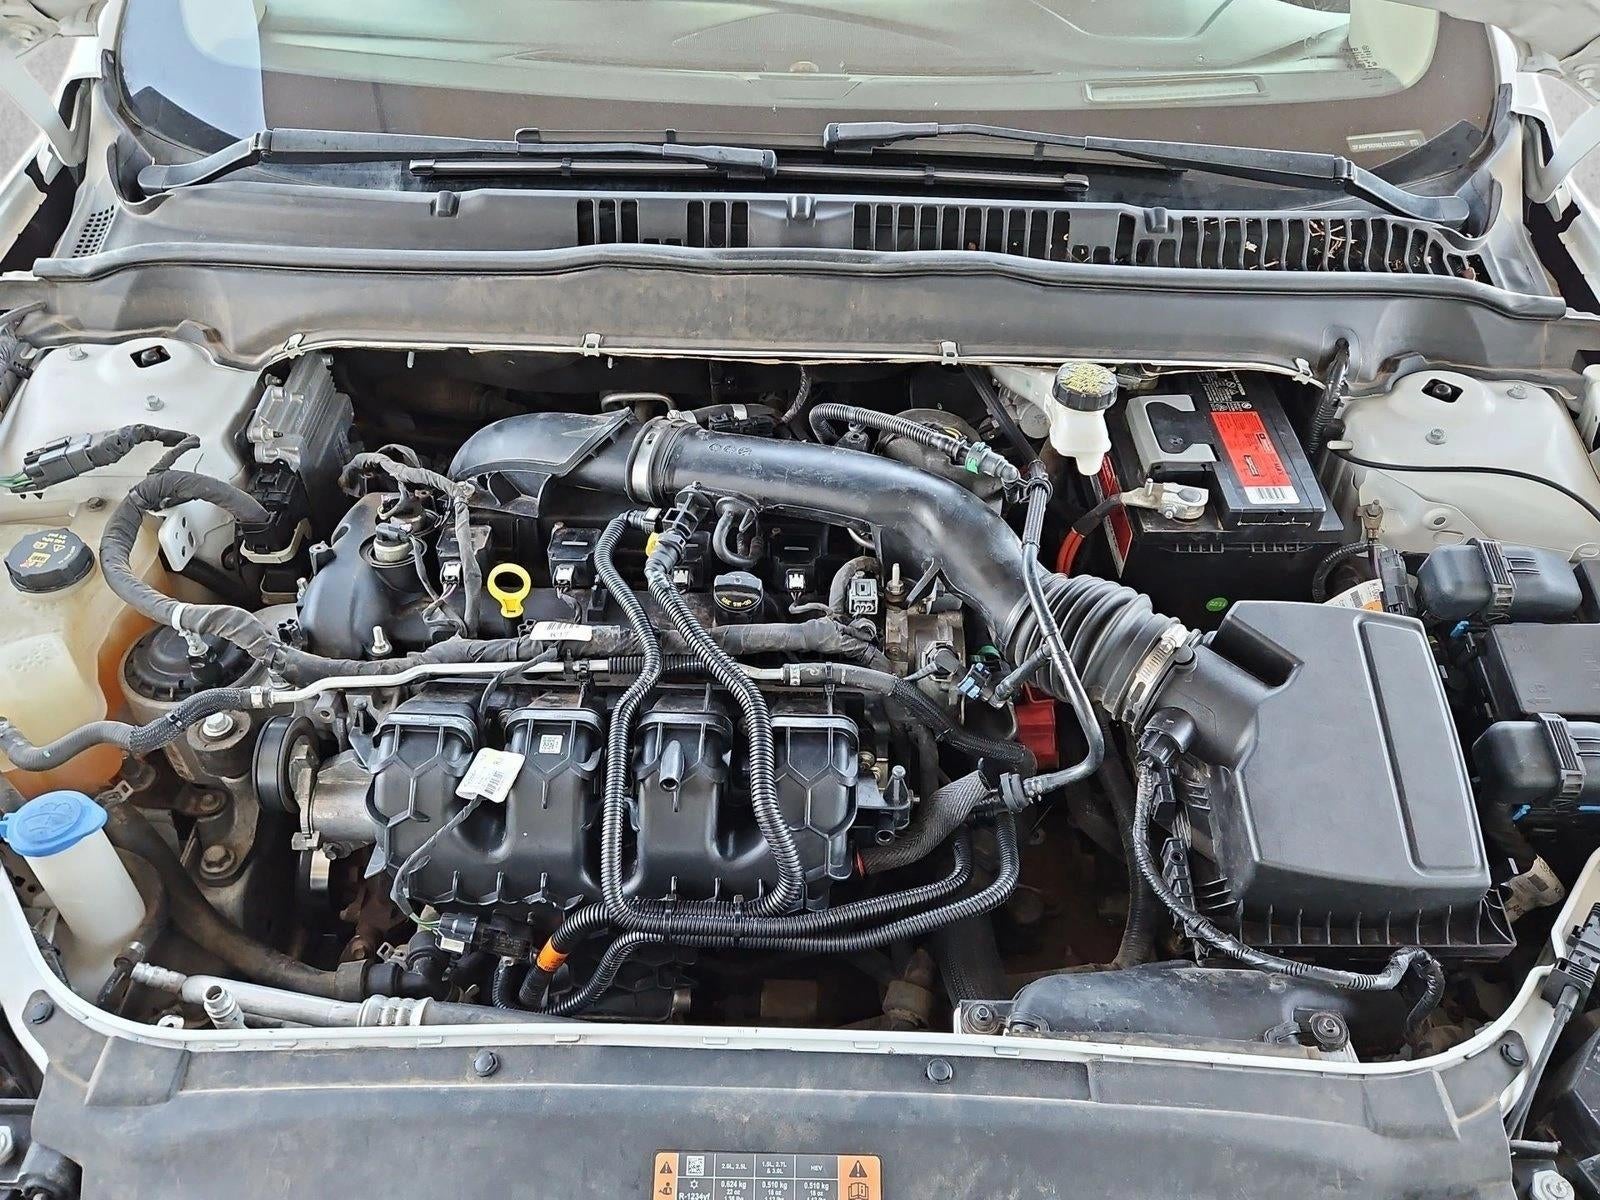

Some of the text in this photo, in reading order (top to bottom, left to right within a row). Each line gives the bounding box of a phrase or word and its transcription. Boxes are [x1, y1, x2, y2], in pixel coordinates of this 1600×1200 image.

[738, 1180, 747, 1190] kg
[761, 1180, 788, 1191] 0.510 kg
[803, 1181, 830, 1191] 0.510 kg
